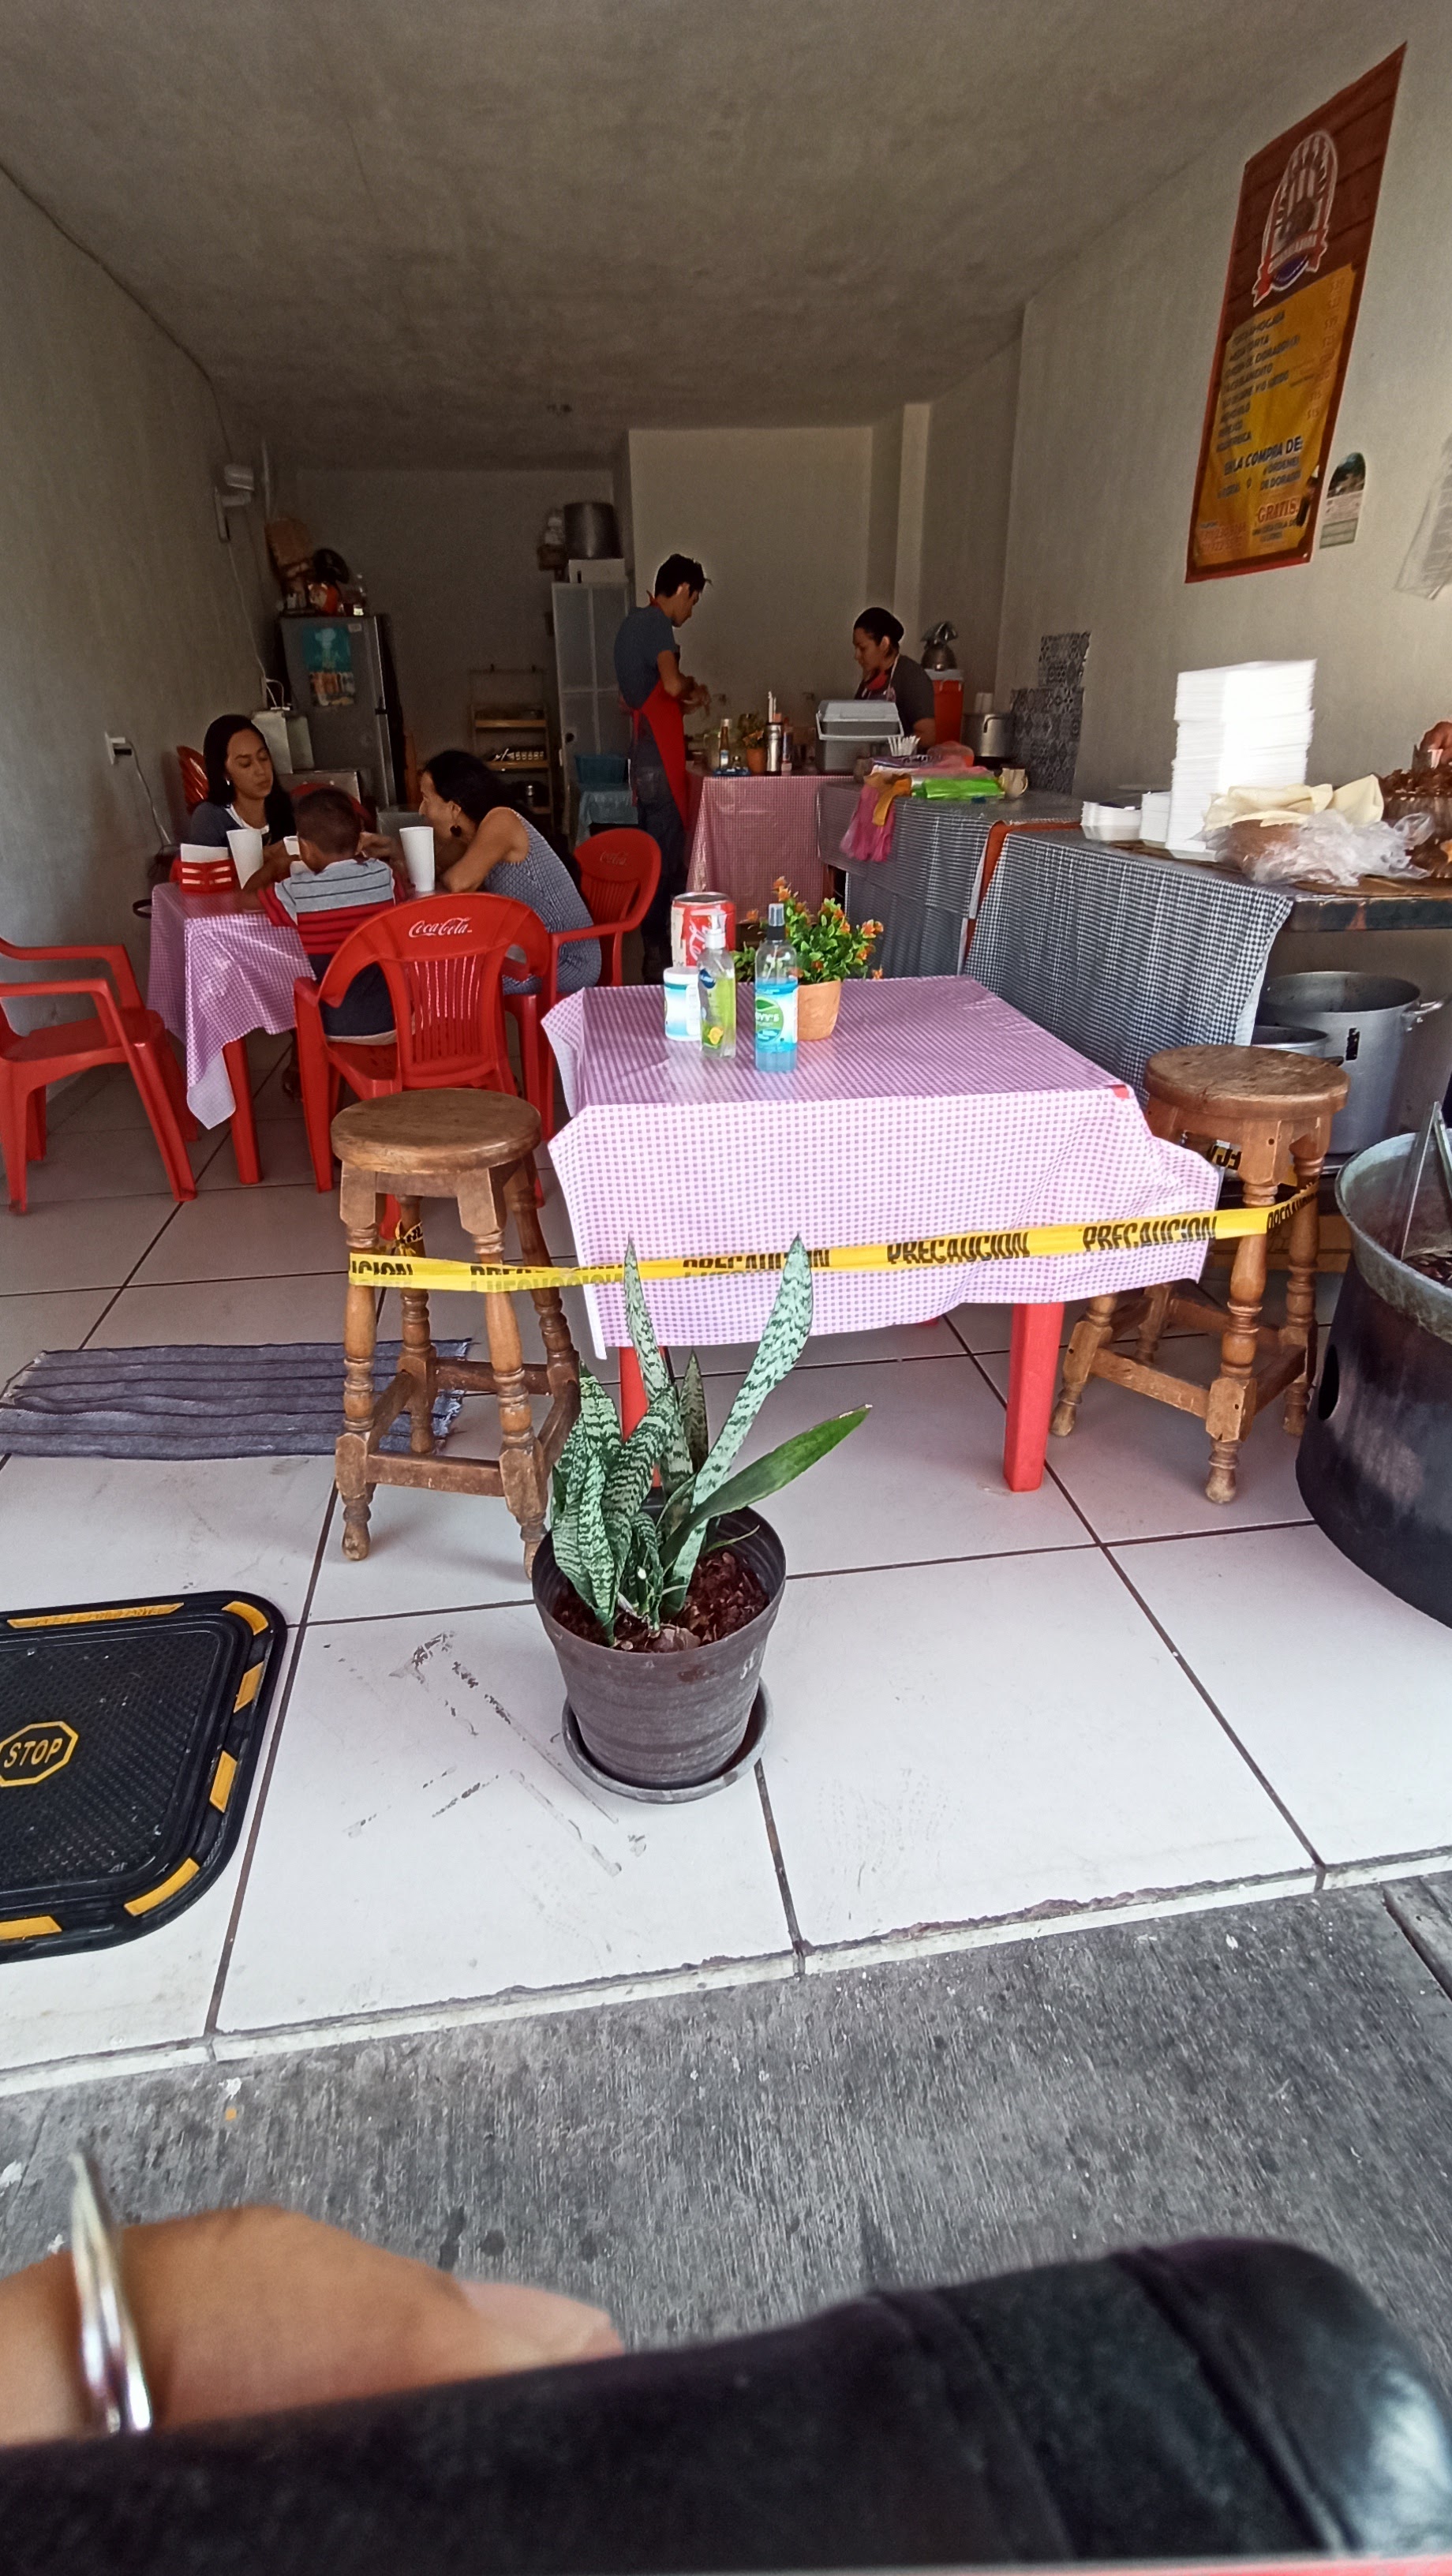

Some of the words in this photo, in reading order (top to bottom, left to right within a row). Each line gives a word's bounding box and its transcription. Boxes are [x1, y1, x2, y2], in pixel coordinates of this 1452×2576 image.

[1244, 442, 1284, 468] COMPRA
[887, 1232, 1031, 1264] PRECAUCION
[1083, 1216, 1218, 1252] PRECAUCION
[3, 1737, 63, 1769] STOP
